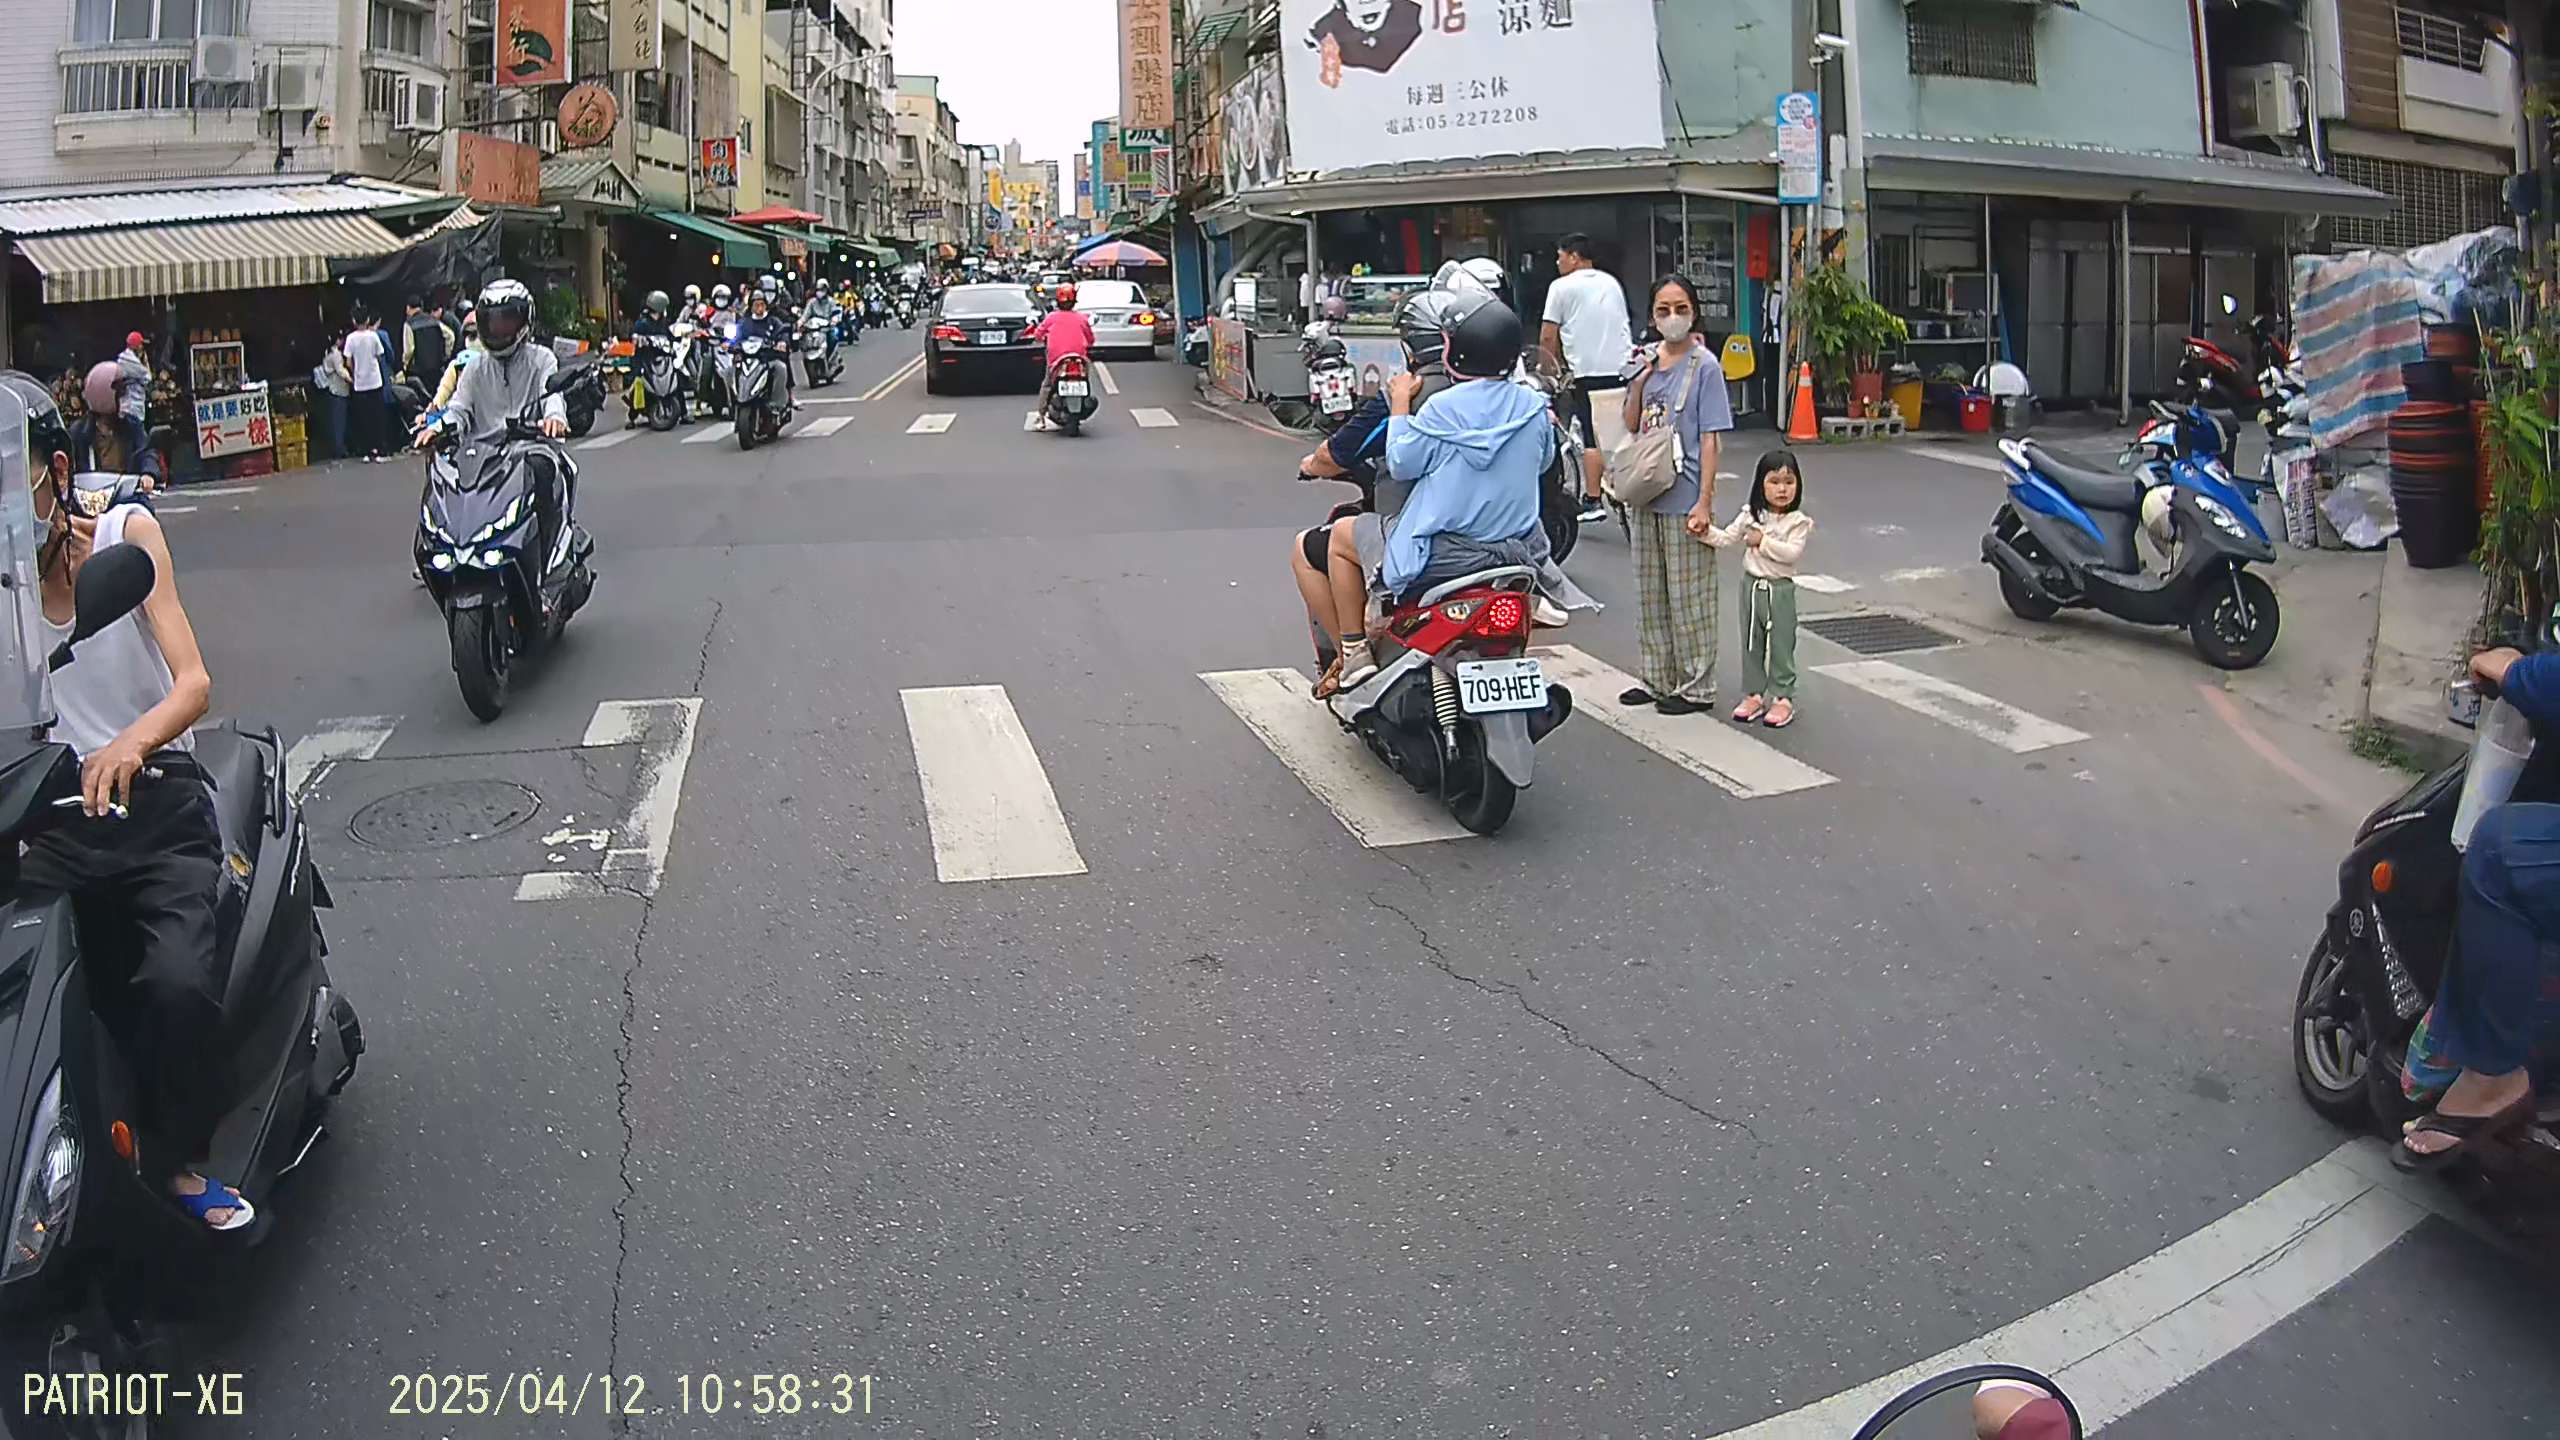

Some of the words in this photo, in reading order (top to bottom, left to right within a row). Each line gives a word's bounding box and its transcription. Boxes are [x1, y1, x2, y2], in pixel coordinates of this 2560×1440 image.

[1407, 76, 1510, 106] 每週三公休
[199, 416, 271, 453] 不一樣
